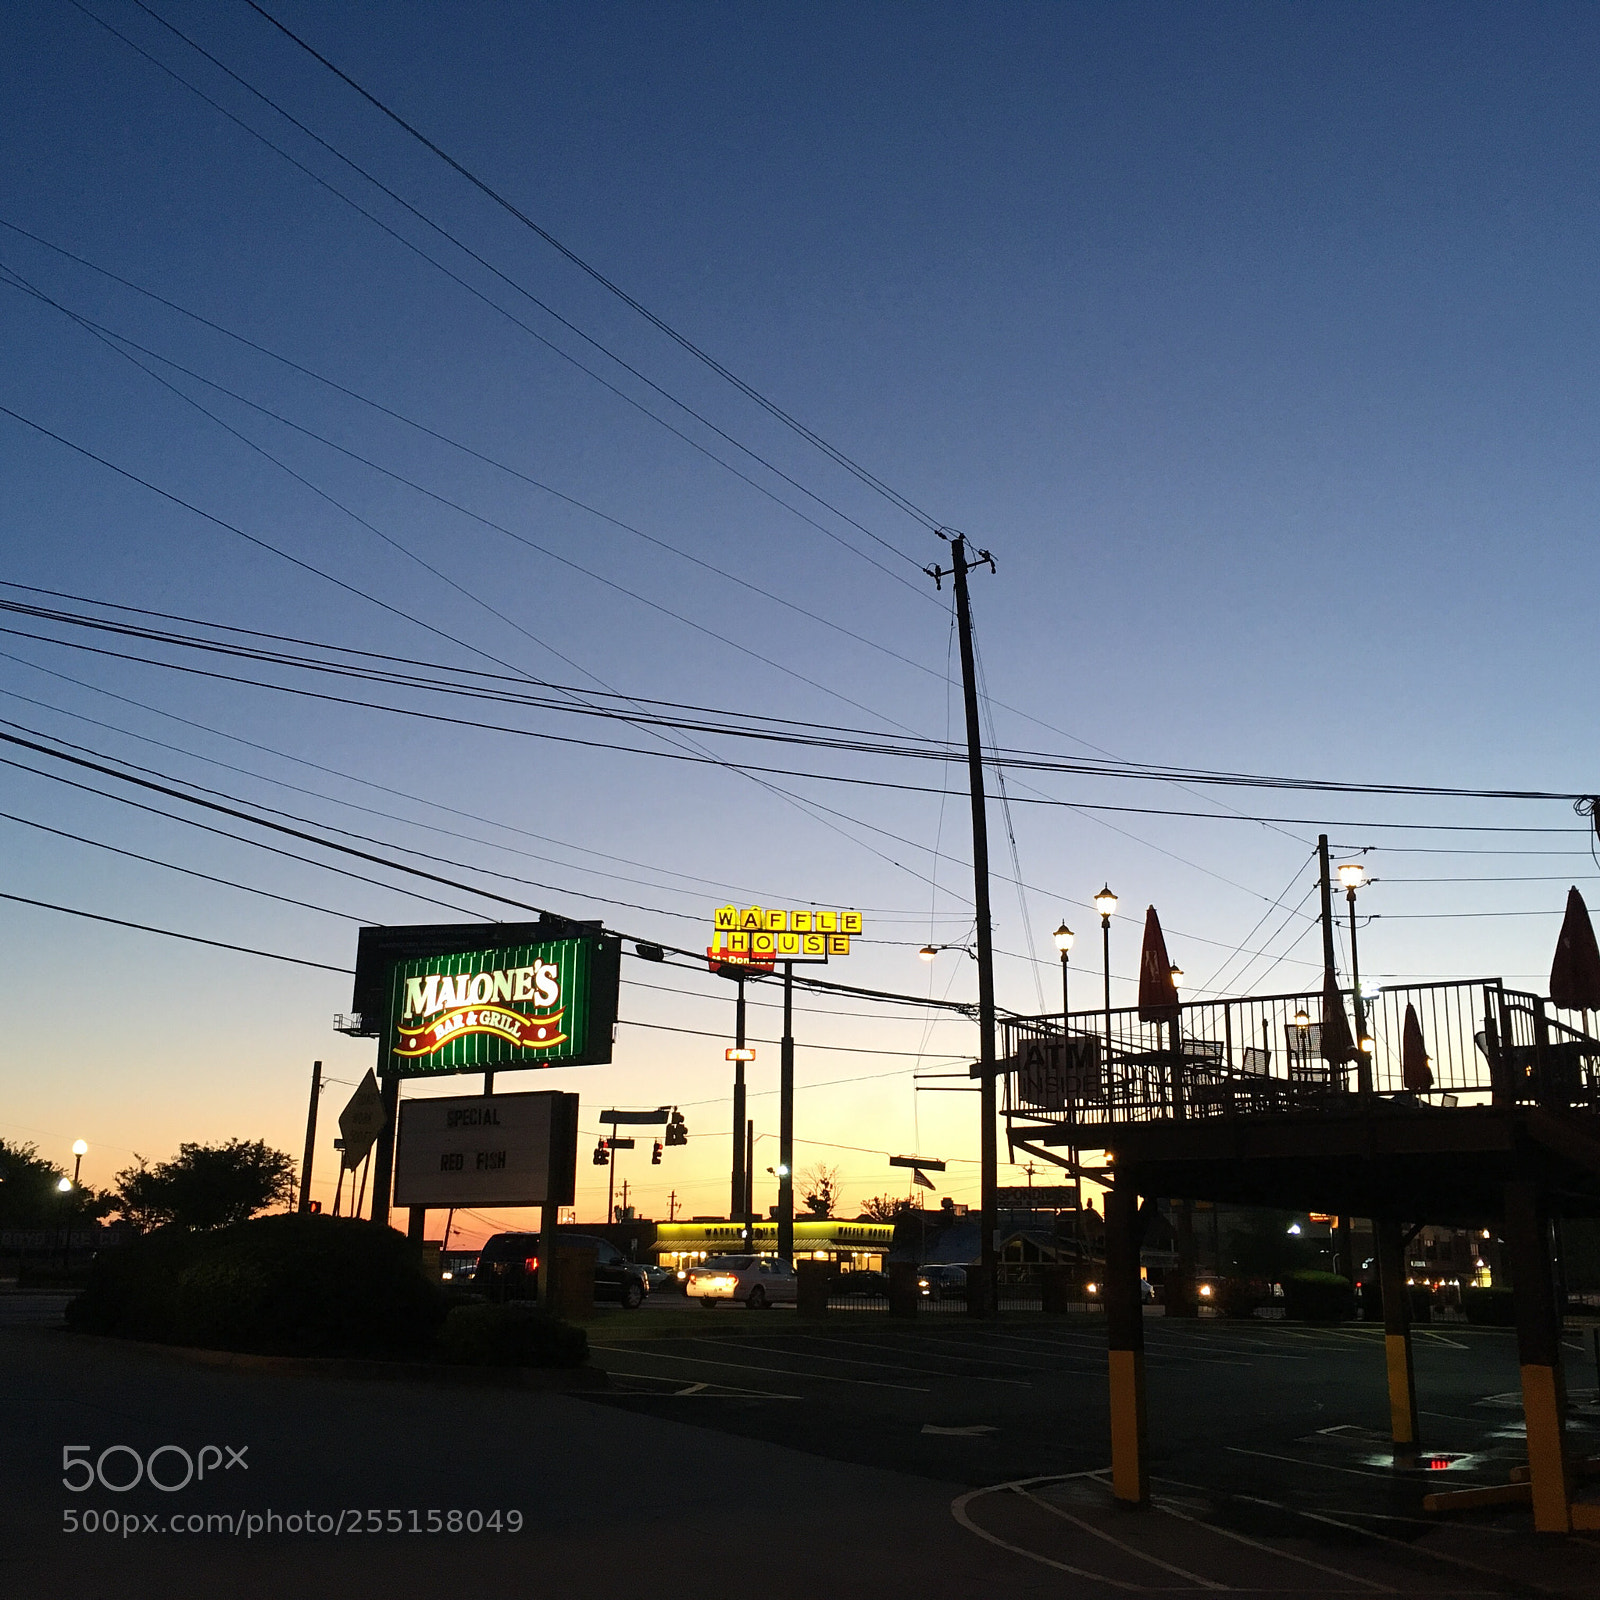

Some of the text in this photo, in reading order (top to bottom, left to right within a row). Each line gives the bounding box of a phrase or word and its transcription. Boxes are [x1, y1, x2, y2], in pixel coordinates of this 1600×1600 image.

[719, 912, 858, 930] WAFFLE
[732, 934, 846, 952] HOUSE
[403, 957, 559, 1019] MALONE'S
[433, 1011, 522, 1041] BAR & GRILL
[1024, 1043, 1094, 1069] ATM
[1022, 1075, 1098, 1095] INSIDE
[447, 1108, 500, 1127] SPECIAL
[440, 1151, 506, 1171] RED FISH
[838, 1226, 891, 1237] WAFFLE HOUSE
